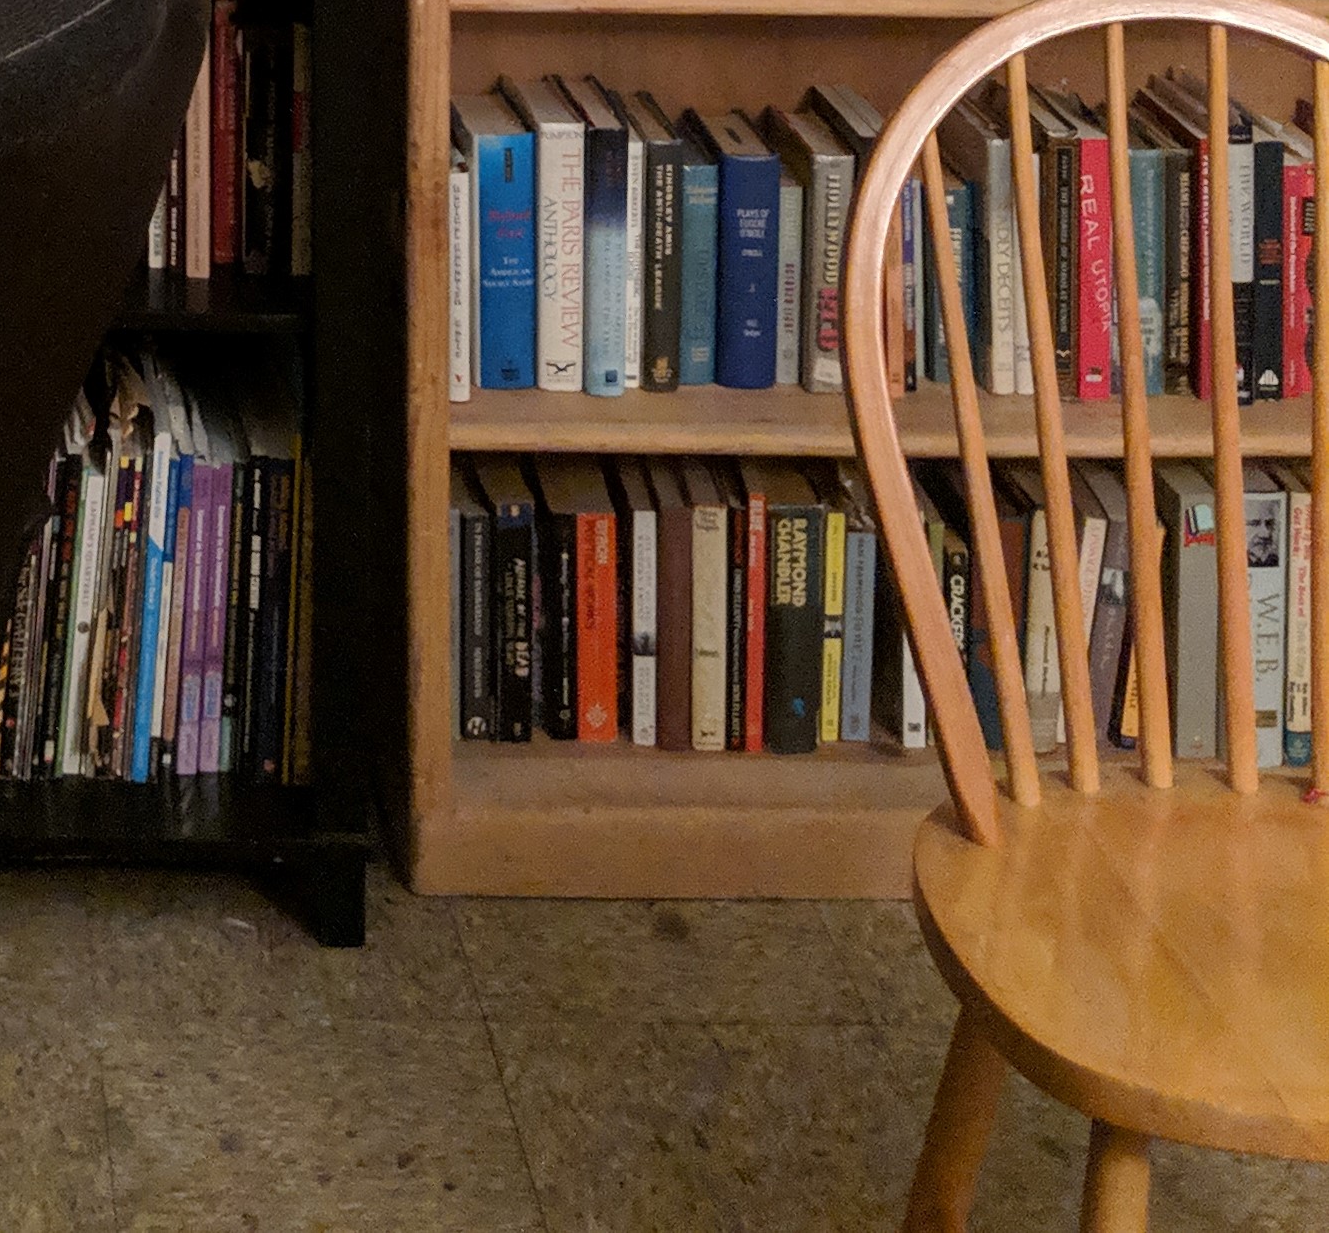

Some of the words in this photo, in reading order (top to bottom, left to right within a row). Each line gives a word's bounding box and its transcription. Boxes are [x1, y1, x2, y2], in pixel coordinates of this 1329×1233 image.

[562, 149, 580, 191] THE
[665, 164, 673, 222] KINGSLEY
[543, 196, 558, 301] ANTHOLOGY
[561, 200, 580, 256] PARIS
[823, 175, 840, 283] HOLLYWOOD
[1080, 175, 1100, 249] REAL
[1091, 260, 1111, 332] UTOPIA
[561, 262, 580, 348] REVIEW
[776, 519, 791, 604] CHANDLER
[792, 518, 807, 606] RAYMOND
[1256, 594, 1279, 682] W.E.B.
